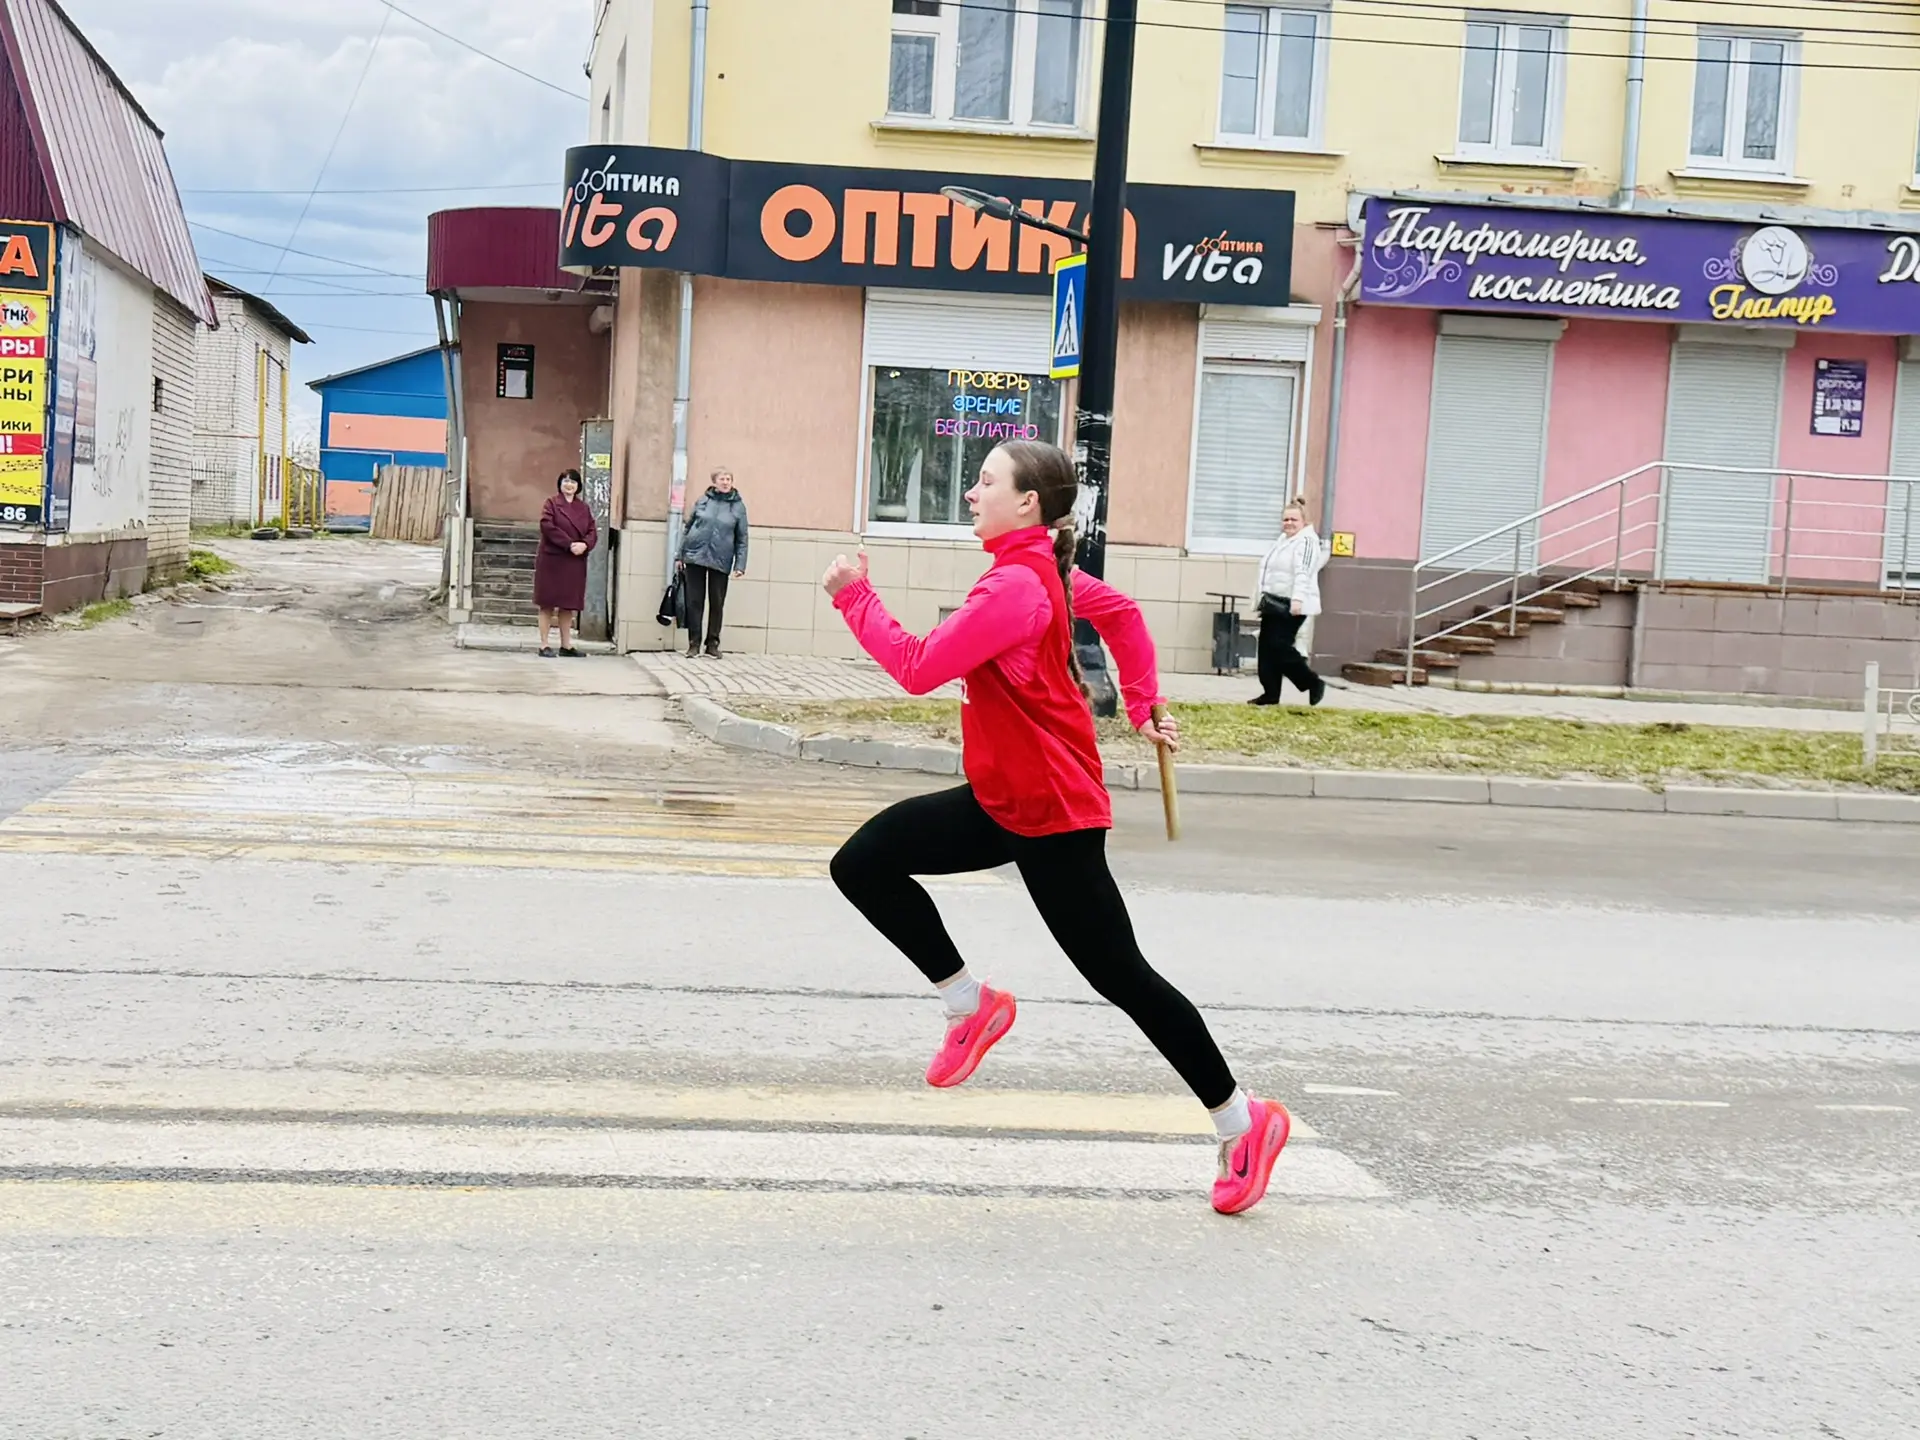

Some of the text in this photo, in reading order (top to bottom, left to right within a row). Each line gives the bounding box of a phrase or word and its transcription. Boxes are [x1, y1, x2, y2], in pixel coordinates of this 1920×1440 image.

[1374, 206, 1647, 273] Парфюмерия,
[1163, 242, 1263, 285] Vita
[1879, 236, 1920, 284] Д
[1468, 272, 1681, 310] косметика
[1709, 284, 1837, 324] Гламур
[947, 369, 1030, 391] ПРОВЕРЬ
[952, 395, 1022, 415] ЗРЕНИЕ
[935, 418, 1038, 440] БЕСПЛАТНО
